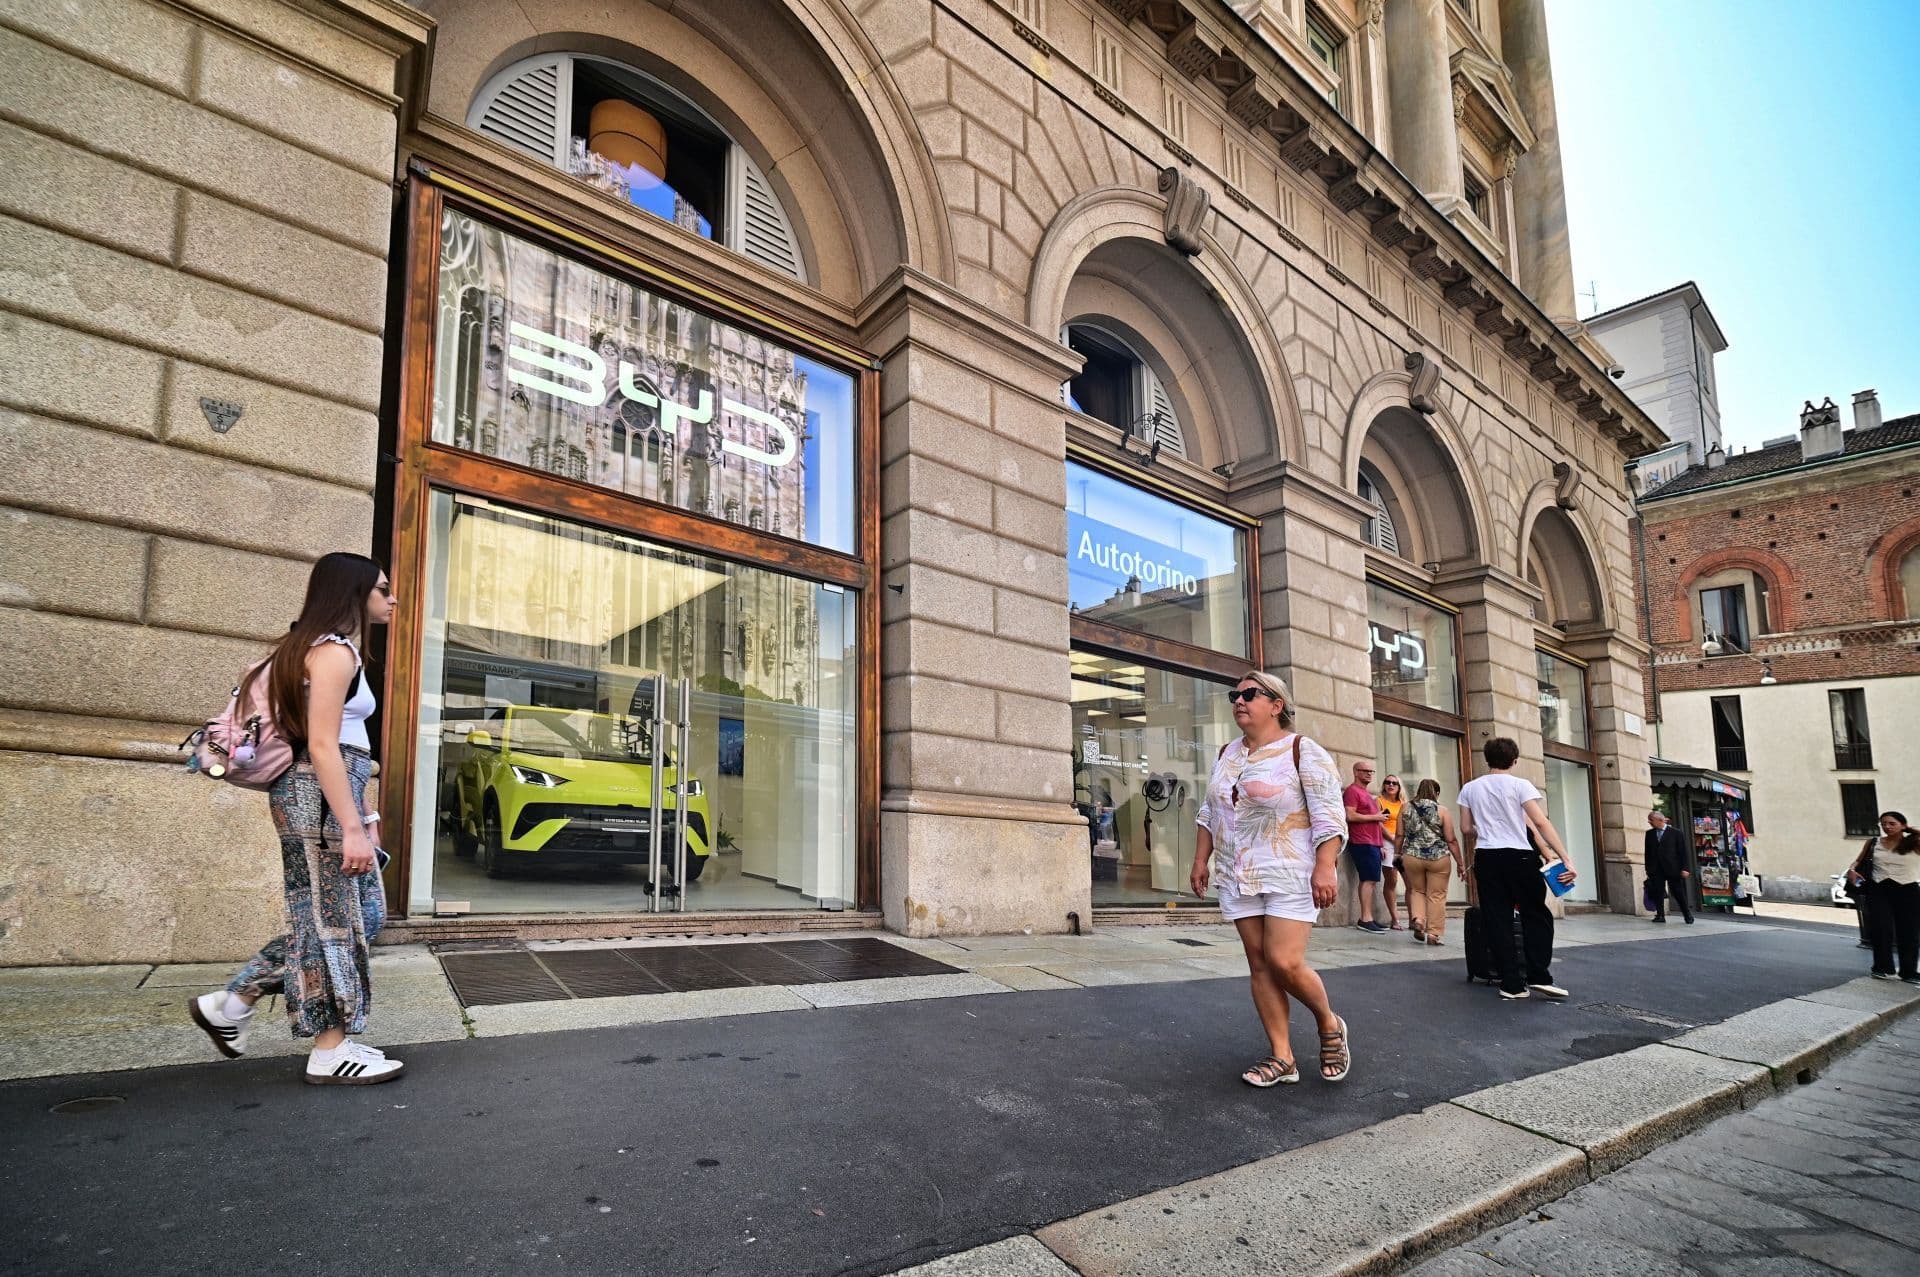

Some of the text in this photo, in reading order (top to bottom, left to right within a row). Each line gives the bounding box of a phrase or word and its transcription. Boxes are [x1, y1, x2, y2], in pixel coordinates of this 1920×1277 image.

[508, 321, 796, 467] BYD
[1078, 531, 1197, 596] Autotorino
[1368, 626, 1424, 669] YD
[634, 697, 653, 711] BY
